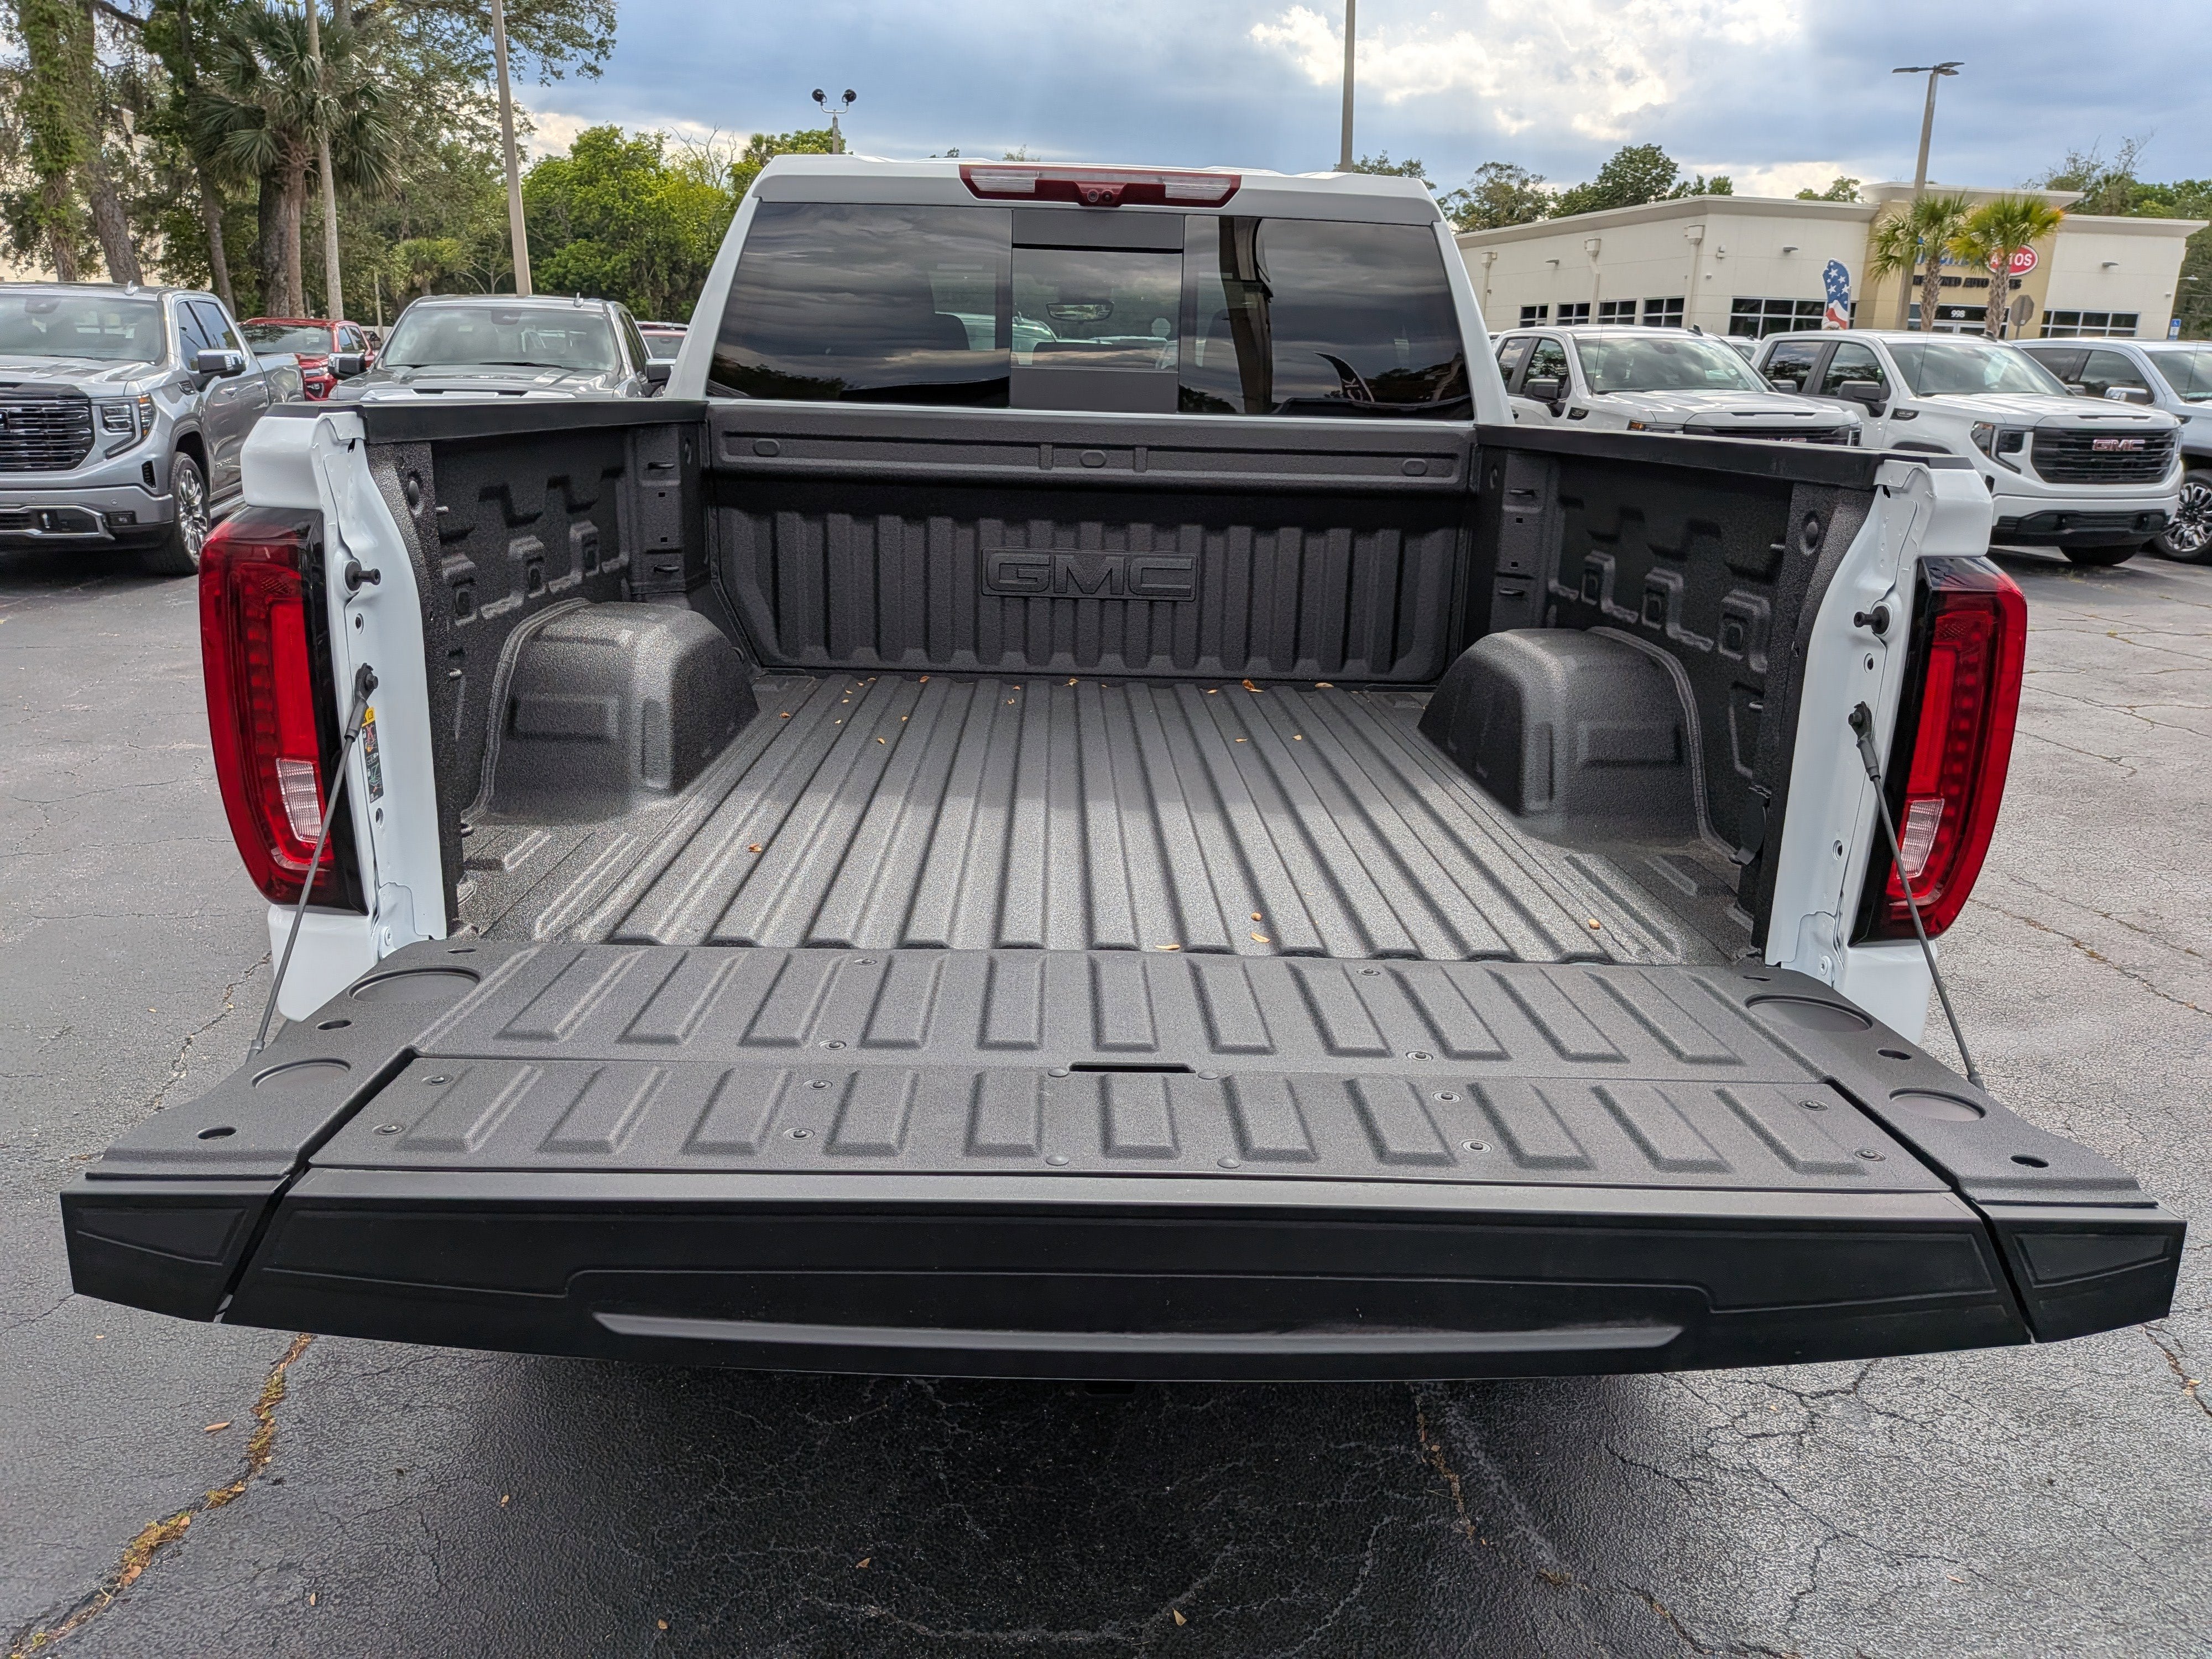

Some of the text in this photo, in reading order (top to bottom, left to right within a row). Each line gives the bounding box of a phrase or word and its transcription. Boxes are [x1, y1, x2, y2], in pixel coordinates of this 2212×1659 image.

[1990, 252, 2033, 267] ATOS
[1950, 310, 1966, 318] 998
[2091, 439, 2146, 451] GMC
[986, 552, 1193, 597] GMC
